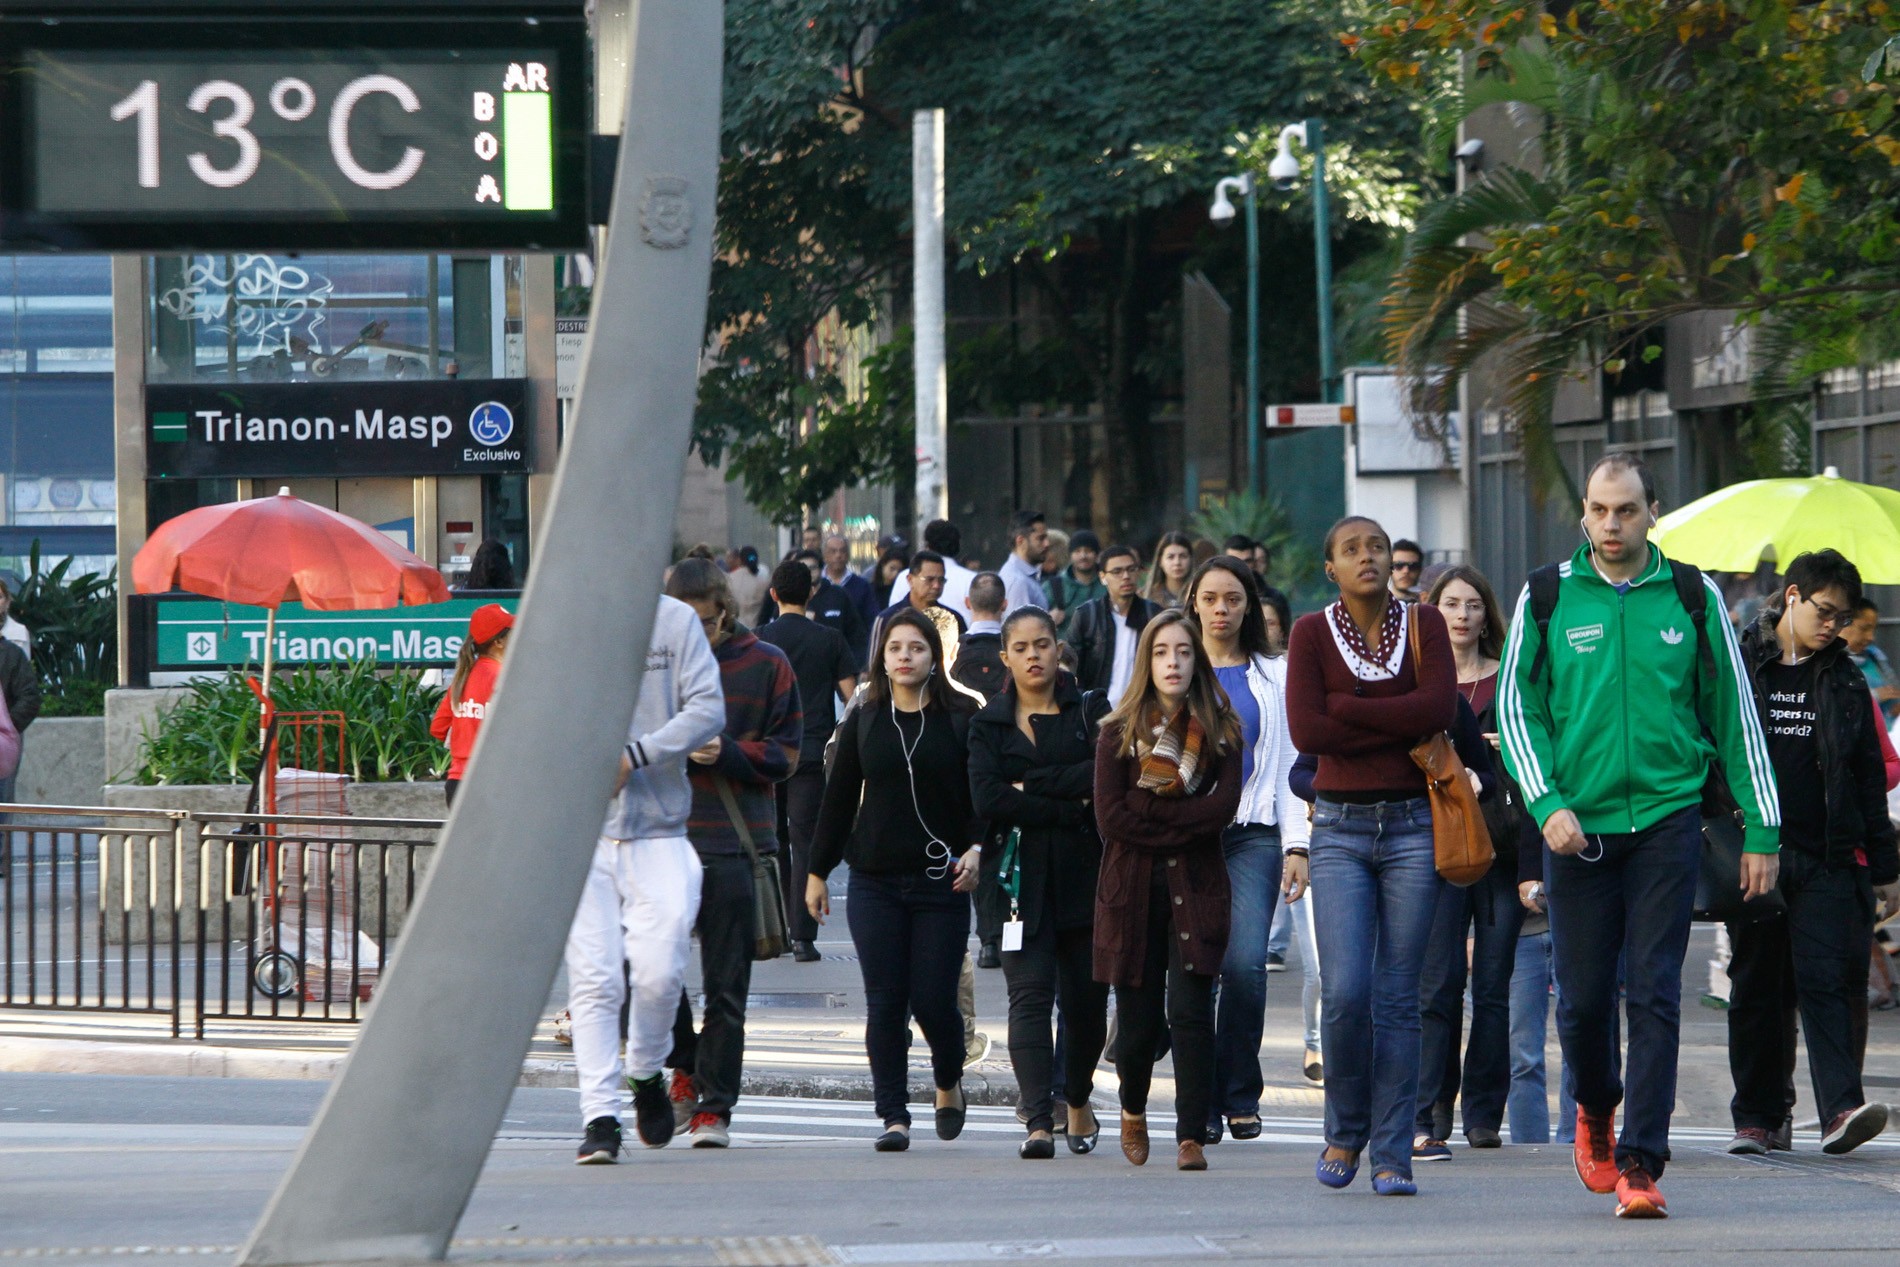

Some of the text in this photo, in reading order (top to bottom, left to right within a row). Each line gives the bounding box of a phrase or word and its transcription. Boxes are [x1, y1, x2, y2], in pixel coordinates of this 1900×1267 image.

[503, 62, 550, 92] AR
[195, 408, 453, 447] Trianon-Masp
[463, 448, 521, 462] Exclusivo
[1570, 628, 1600, 639] GROUPON
[1769, 691, 1806, 703] what if
[1774, 724, 1812, 736] world?
